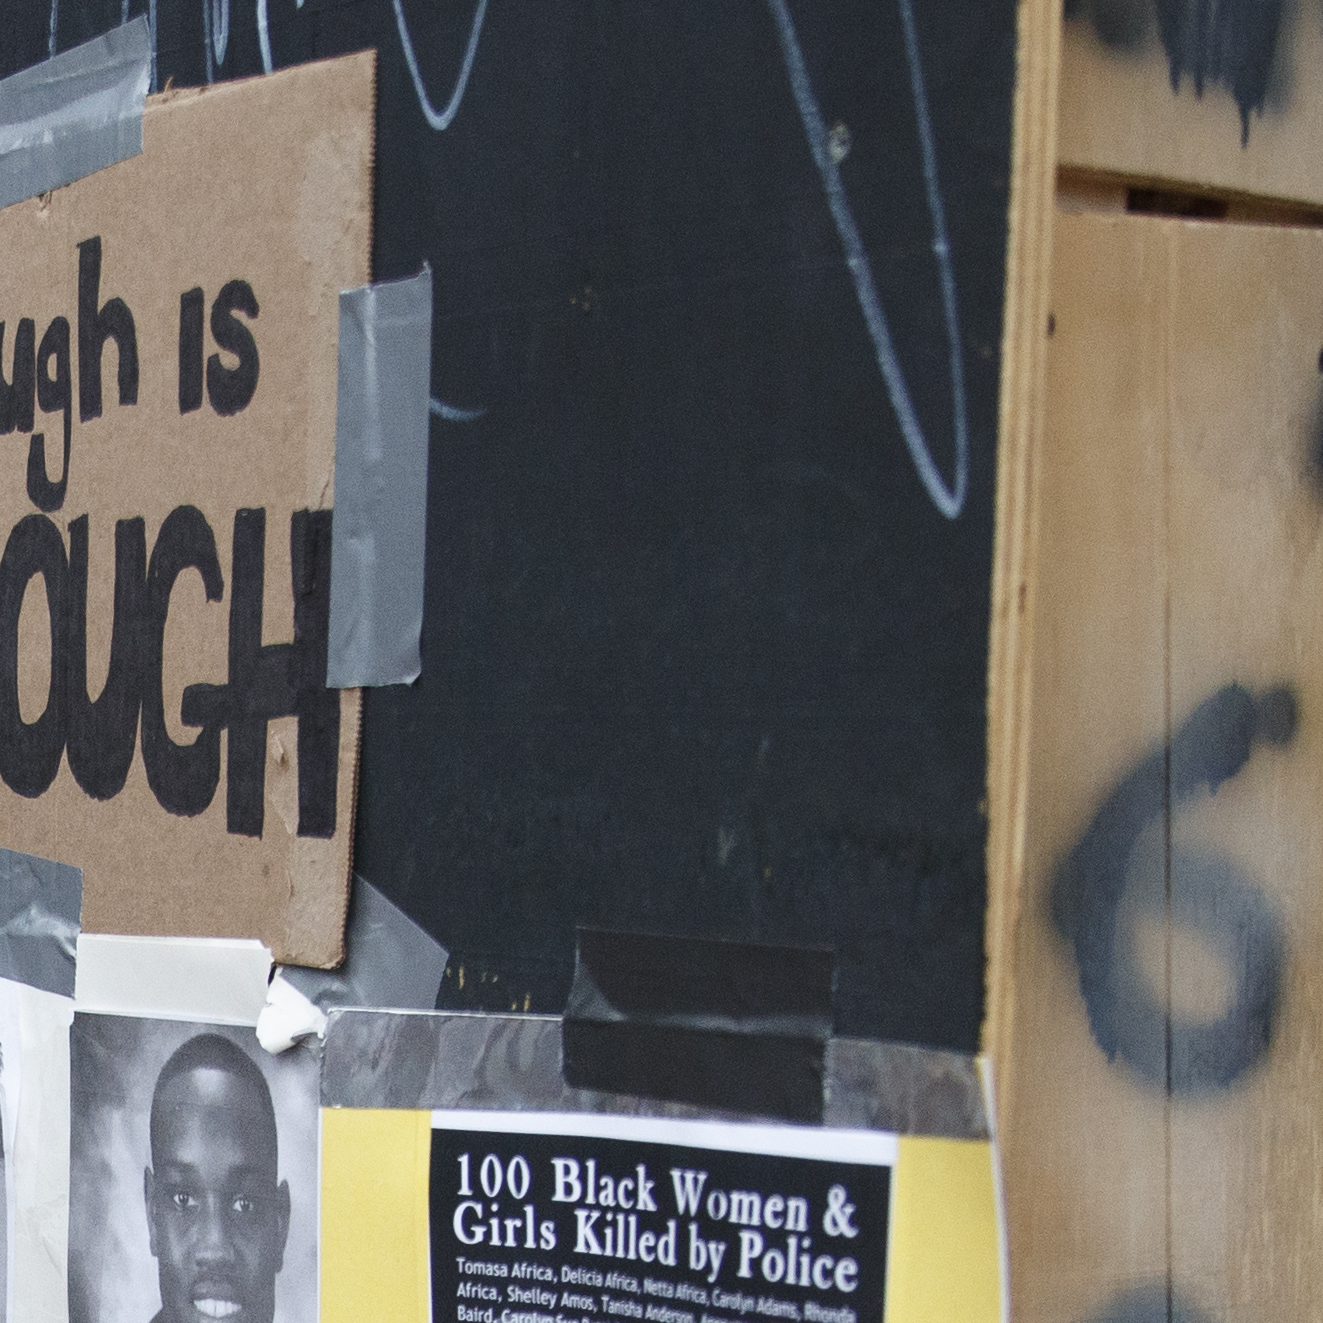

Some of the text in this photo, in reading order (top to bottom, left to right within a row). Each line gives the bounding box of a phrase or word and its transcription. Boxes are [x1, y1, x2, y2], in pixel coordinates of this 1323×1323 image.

[456, 1153, 859, 1239] 100 Black Women &
[452, 1202, 859, 1294] Girls Killed by Police
[456, 1257, 509, 1278] Tomasa
[511, 1261, 558, 1284] Africa,
[456, 1281, 598, 1313] Africa, Shelley Amos,
